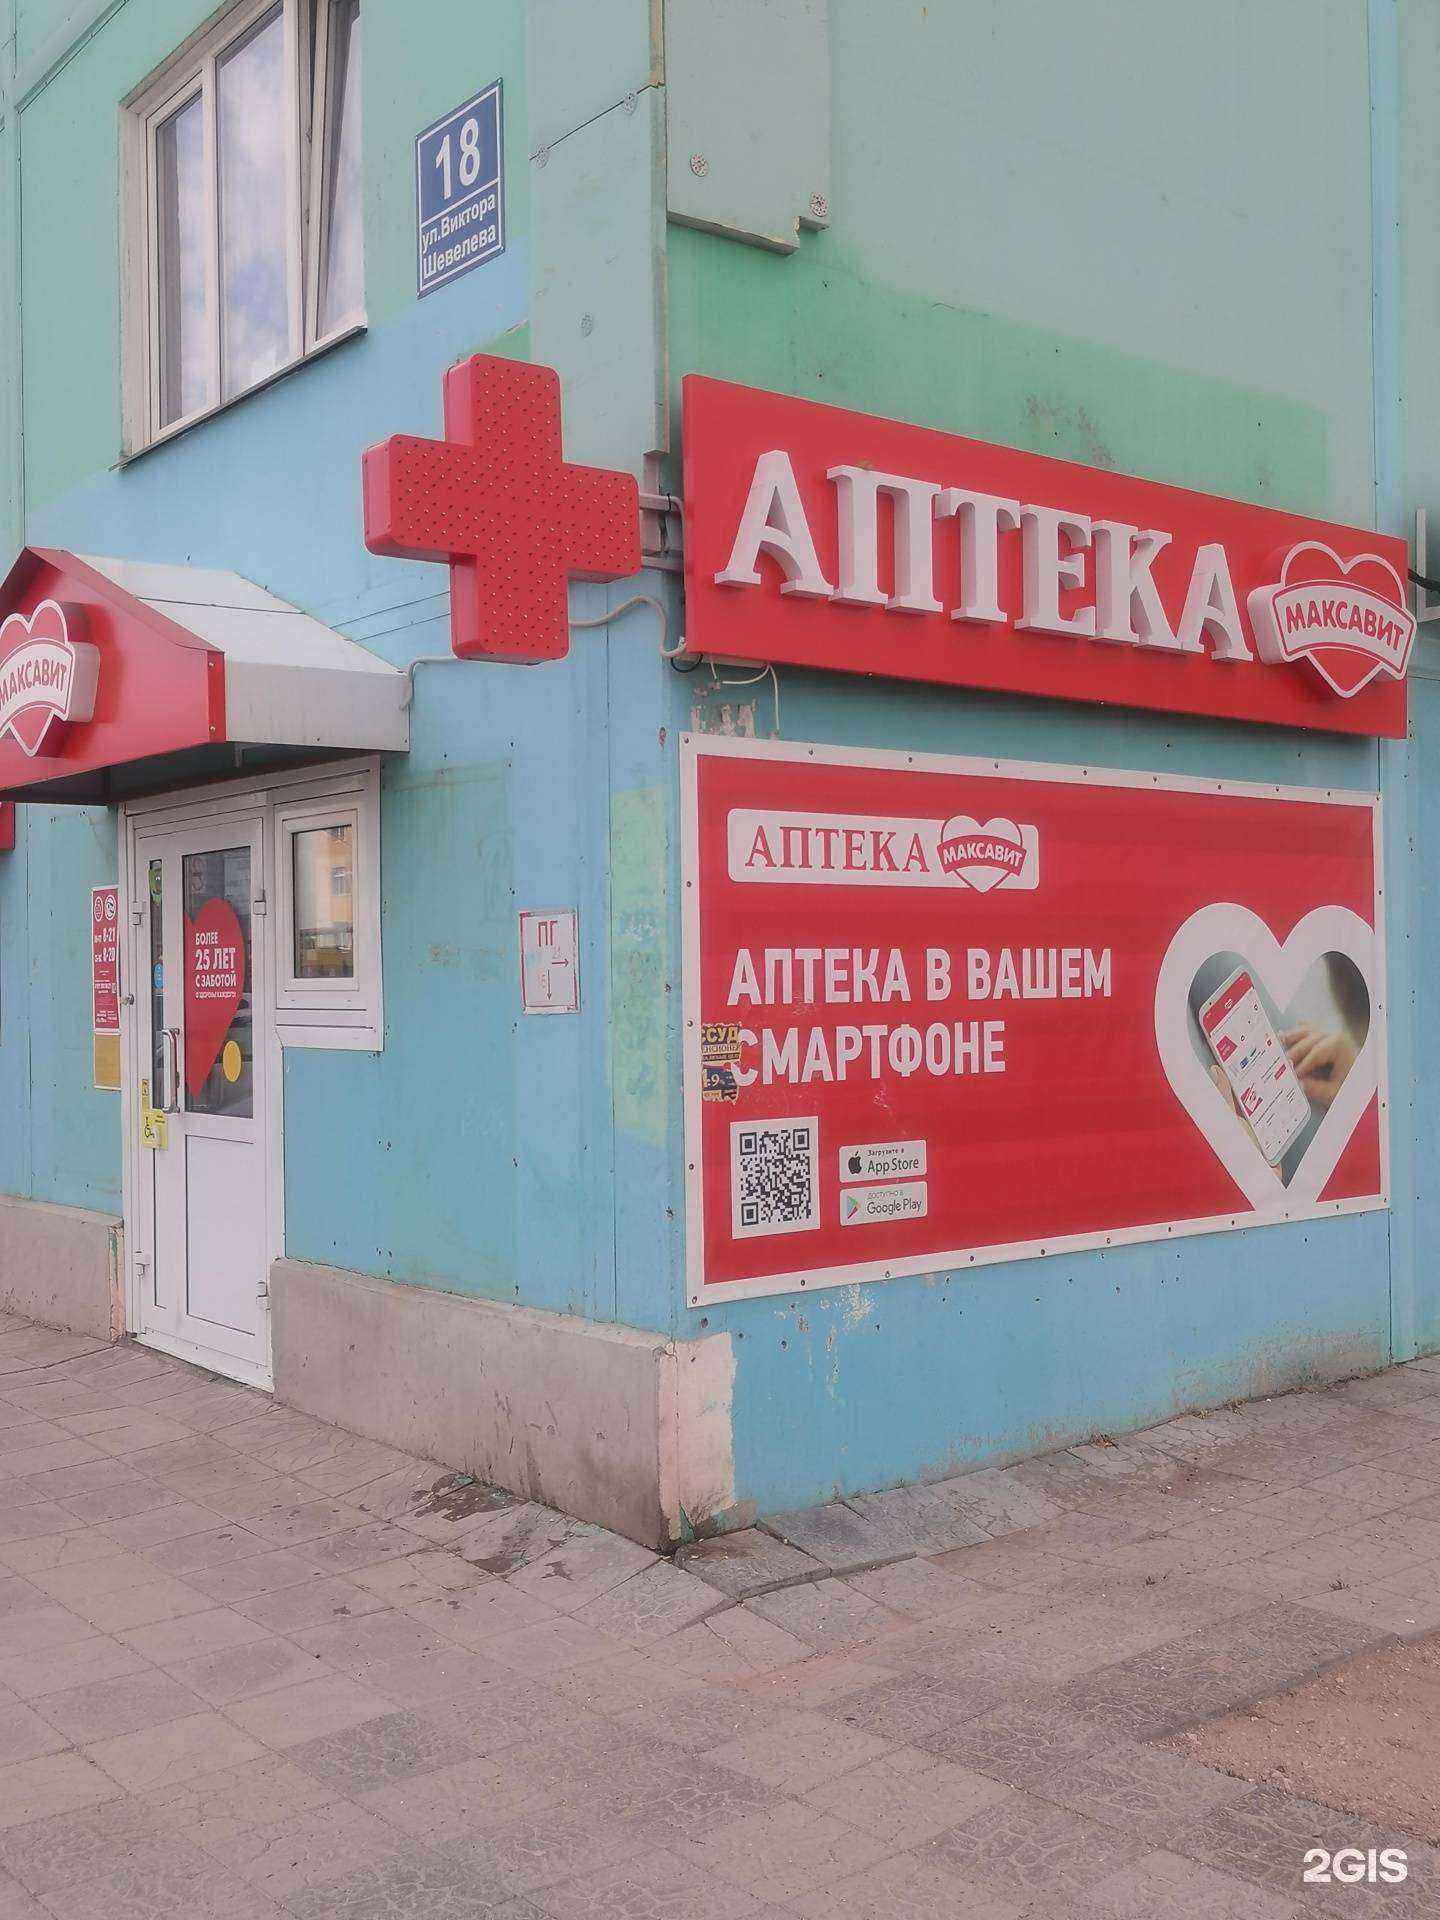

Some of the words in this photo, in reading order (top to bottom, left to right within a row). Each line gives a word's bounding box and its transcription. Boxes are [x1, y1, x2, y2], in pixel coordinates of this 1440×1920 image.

[435, 118, 481, 200] 18
[423, 223, 496, 279] Шевелева
[714, 449, 1254, 662] АПТЕКА
[1285, 600, 1404, 651] МАКСАВИТ
[745, 825, 930, 872] АПТЕКА
[943, 841, 1023, 867] МАКСАВИТ
[195, 931, 219, 945] БОЛЕЕ
[195, 948, 210, 970] 25
[212, 947, 236, 969] ЛЕТ
[195, 974, 200, 987] С
[200, 970, 237, 988] ЗАБОТОЙ
[727, 948, 912, 1006] АПТЕКА
[926, 948, 951, 1001] В
[967, 948, 1112, 1000] ВАШЕМ
[732, 1020, 1006, 1086] СМАРТФОНЕ
[867, 1160, 889, 1175] App
[891, 1157, 919, 1171] Store
[867, 1200, 901, 1215] Google
[903, 1198, 922, 1212] Play
